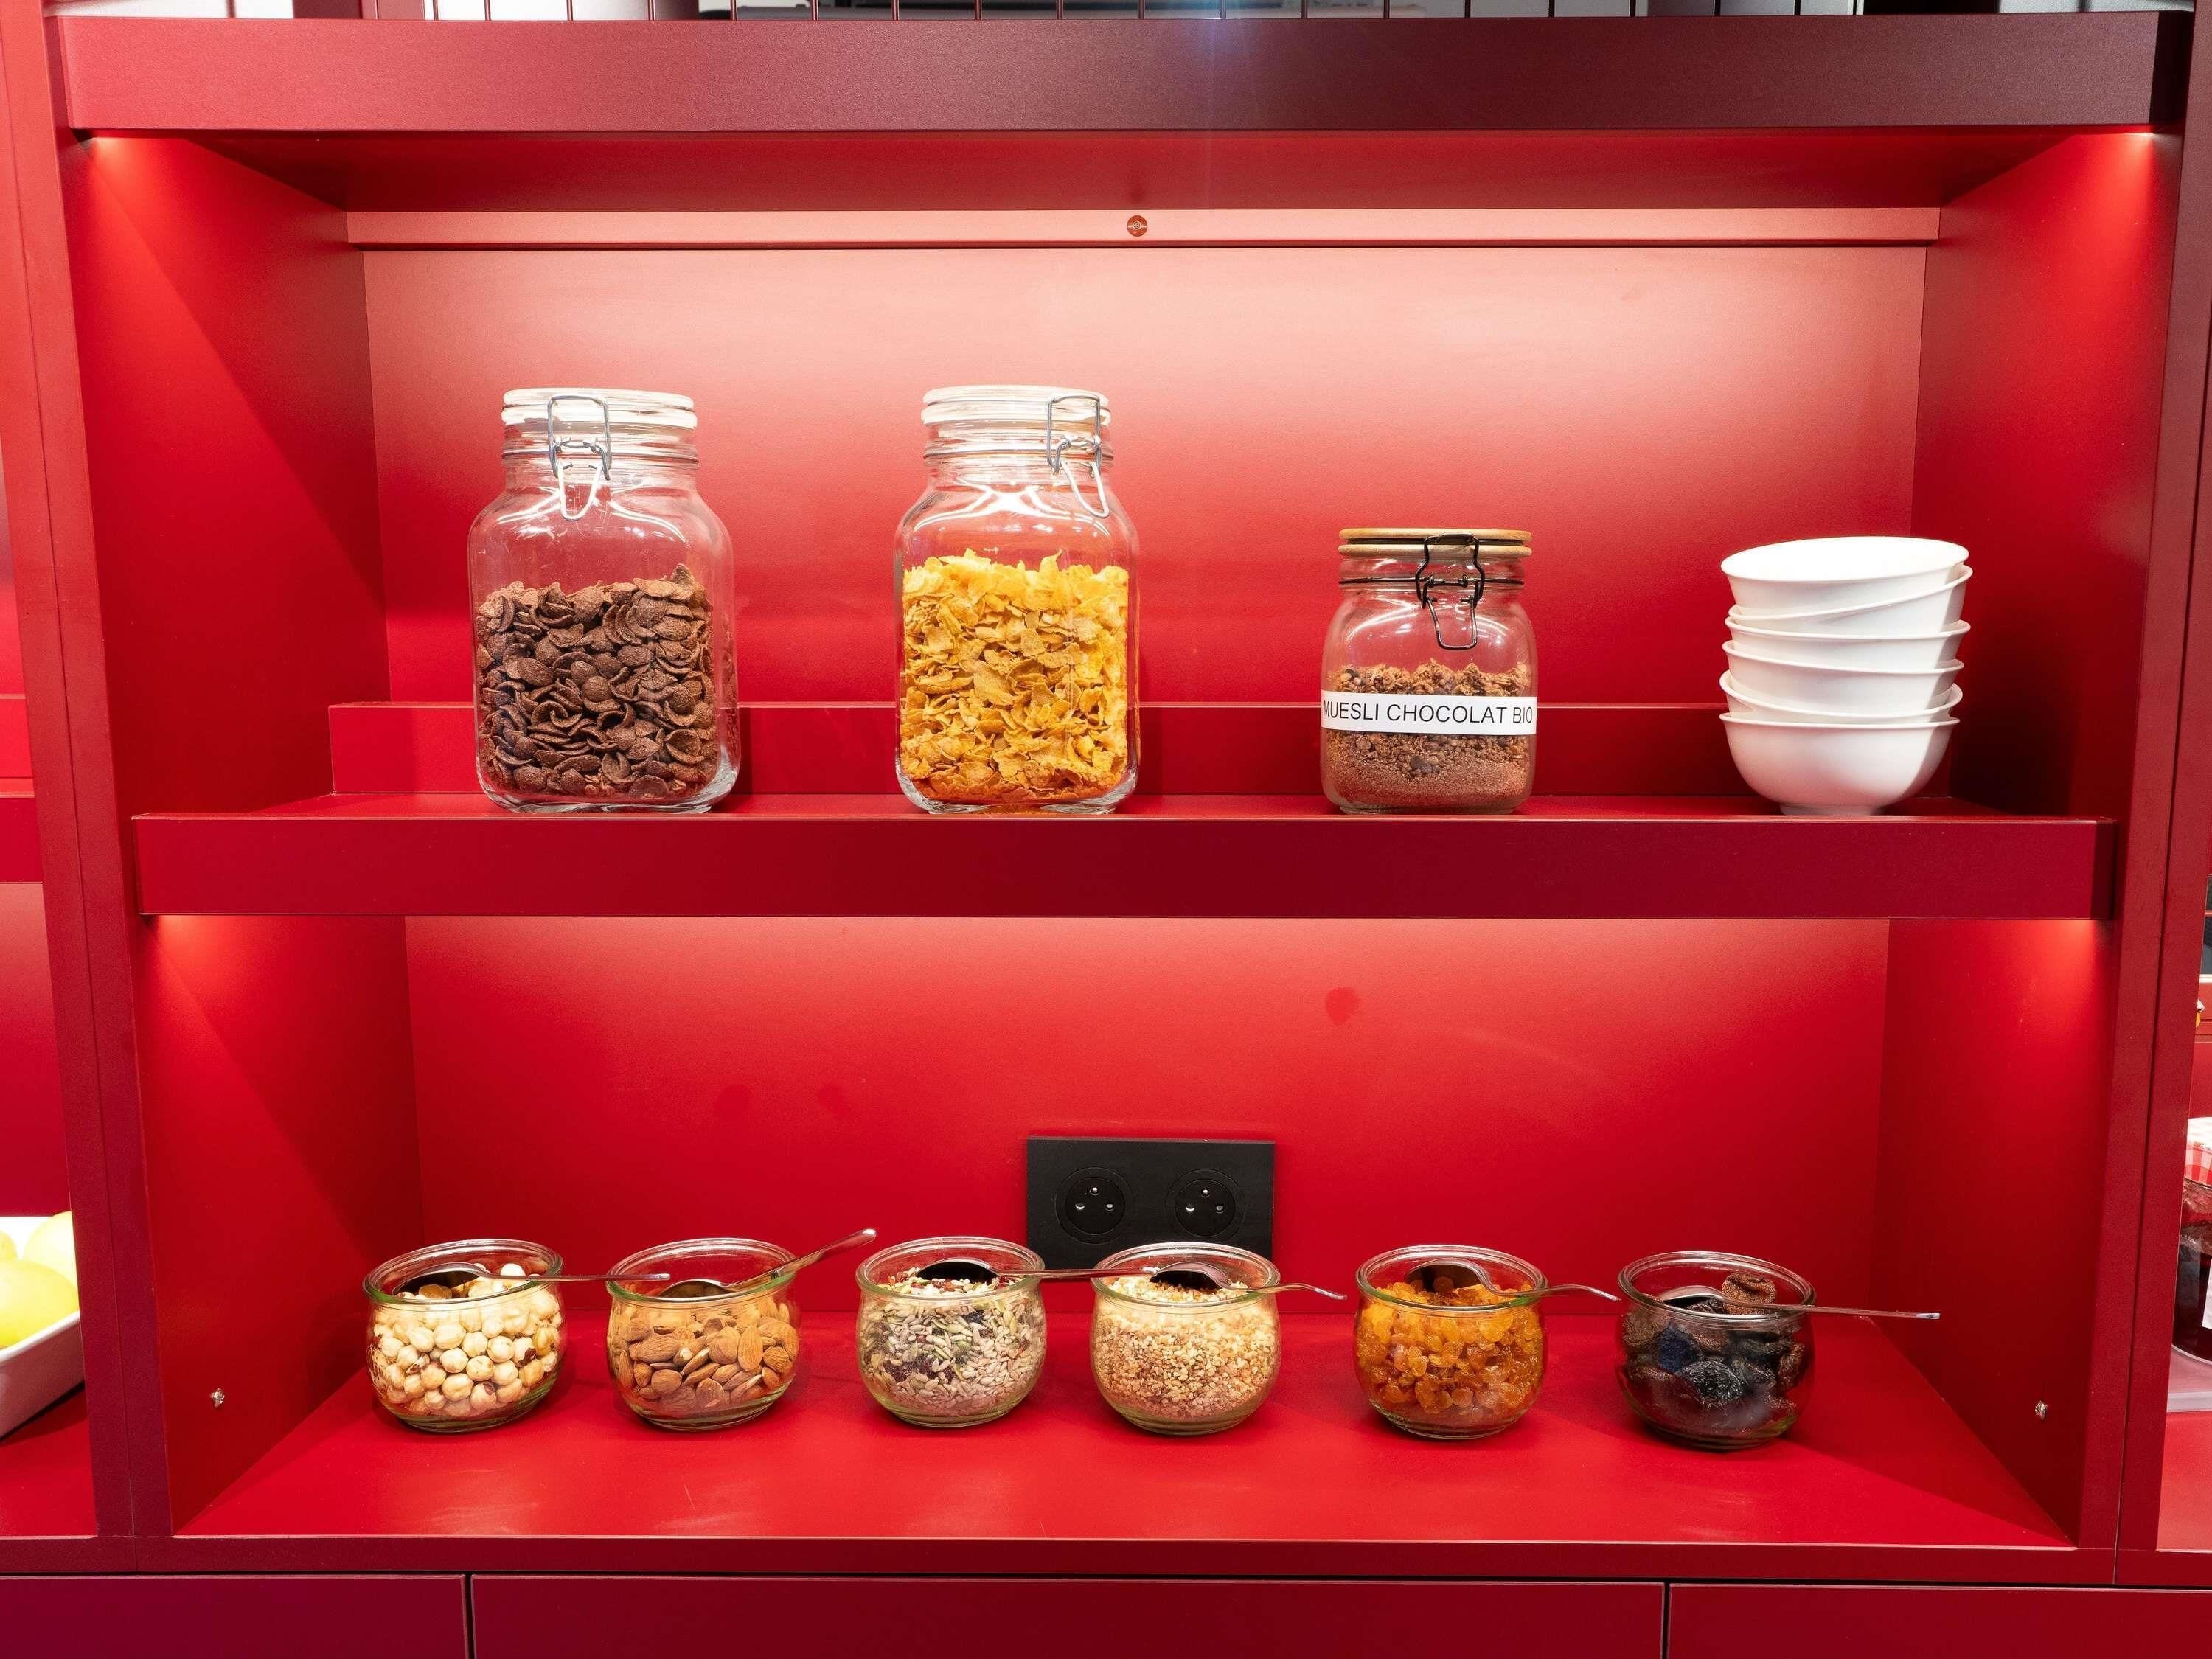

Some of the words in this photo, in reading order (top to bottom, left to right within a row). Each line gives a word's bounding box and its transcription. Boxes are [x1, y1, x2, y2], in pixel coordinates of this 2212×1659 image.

[1323, 700, 1379, 720] MUESLI
[1386, 703, 1507, 723] CHOCOLAT
[1512, 706, 1533, 724] BIO
